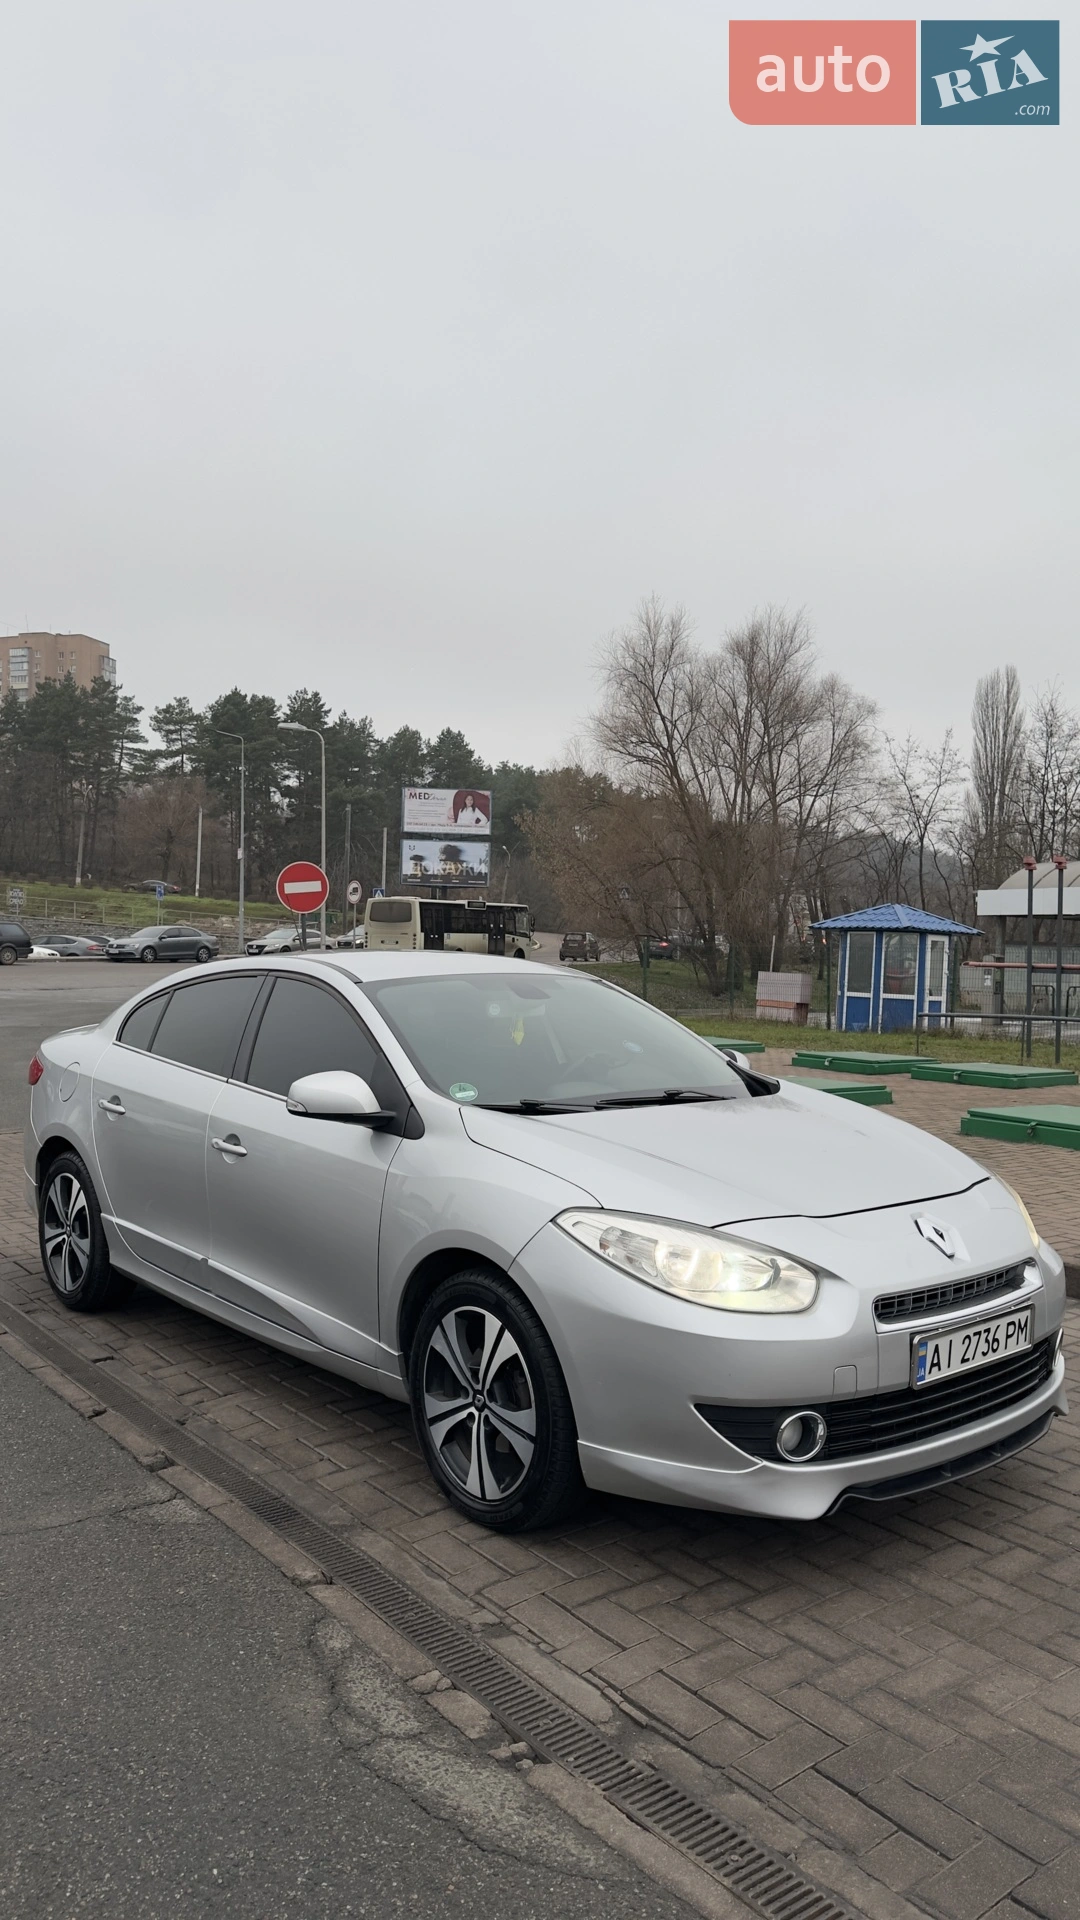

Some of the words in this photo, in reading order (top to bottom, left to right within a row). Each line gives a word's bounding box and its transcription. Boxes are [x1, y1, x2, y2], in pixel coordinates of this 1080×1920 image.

[408, 792, 430, 800] MED
[928, 1339, 953, 1375] AI
[960, 1324, 1001, 1364] 2736
[1004, 1315, 1029, 1350] PM
